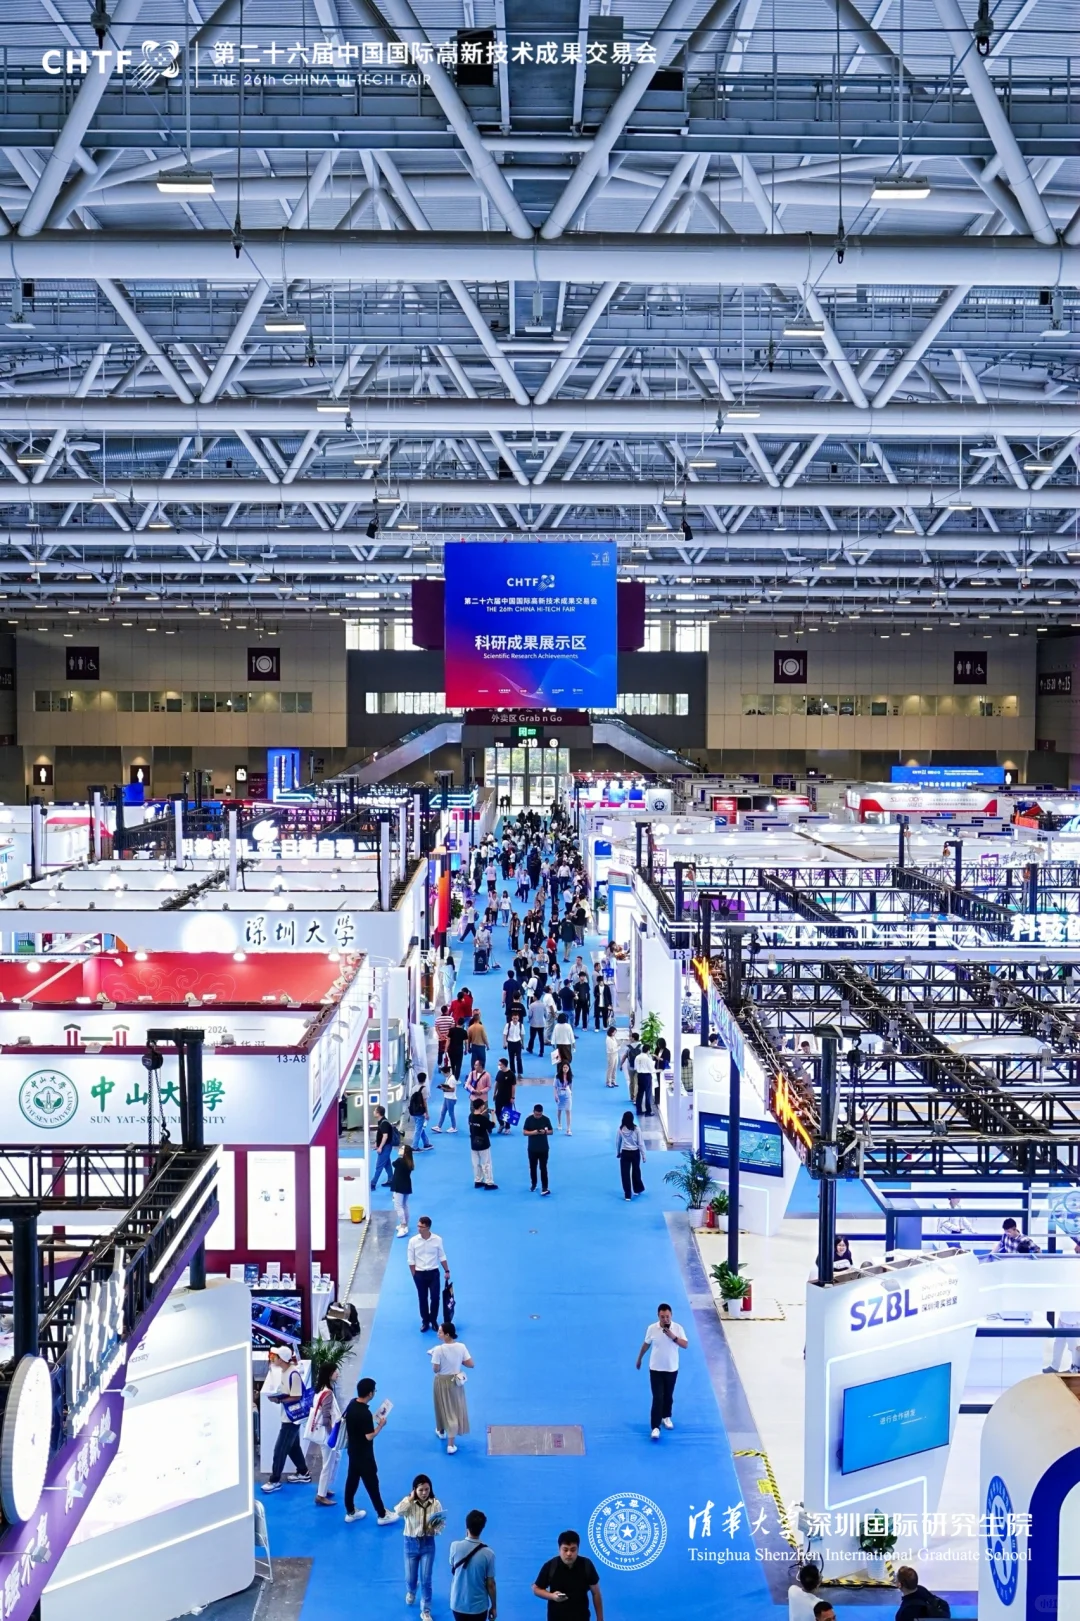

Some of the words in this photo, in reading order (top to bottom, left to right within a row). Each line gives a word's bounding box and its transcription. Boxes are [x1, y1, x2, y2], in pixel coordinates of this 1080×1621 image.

[506, 577, 539, 587] CHTF
[474, 634, 587, 650] 科研成果展示区
[518, 714, 540, 722] Grab
[549, 714, 562, 722] Go
[276, 1055, 306, 1063] 13-A8
[90, 1116, 111, 1124] SUN
[163, 1116, 226, 1124] UNISITY
[850, 1289, 918, 1332] SZBL
